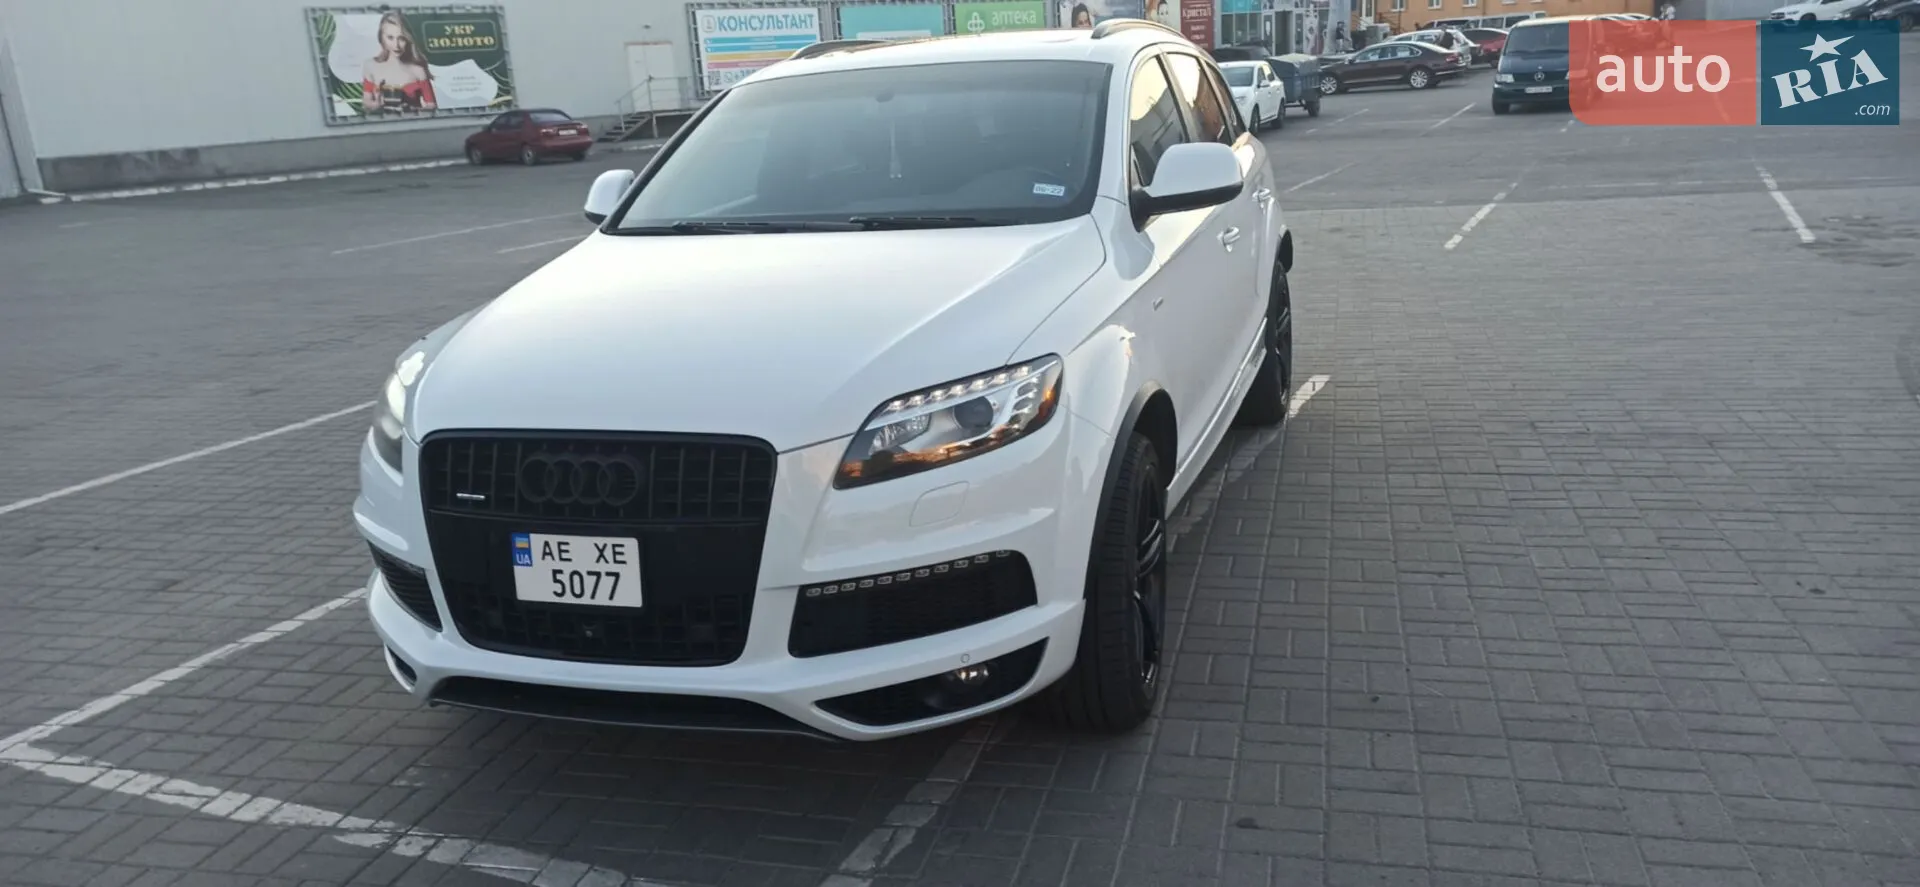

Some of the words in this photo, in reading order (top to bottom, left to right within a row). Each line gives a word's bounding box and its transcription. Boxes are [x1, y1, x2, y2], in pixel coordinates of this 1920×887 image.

[718, 14, 814, 32] КОНСУЛЬТАНТ
[992, 9, 1037, 25] аптека
[444, 25, 475, 34] УКР
[428, 36, 495, 48] ЗОЛОТО
[516, 553, 531, 565] UA
[541, 540, 573, 562] AE
[594, 543, 627, 565] XE
[552, 569, 620, 601] 5077
